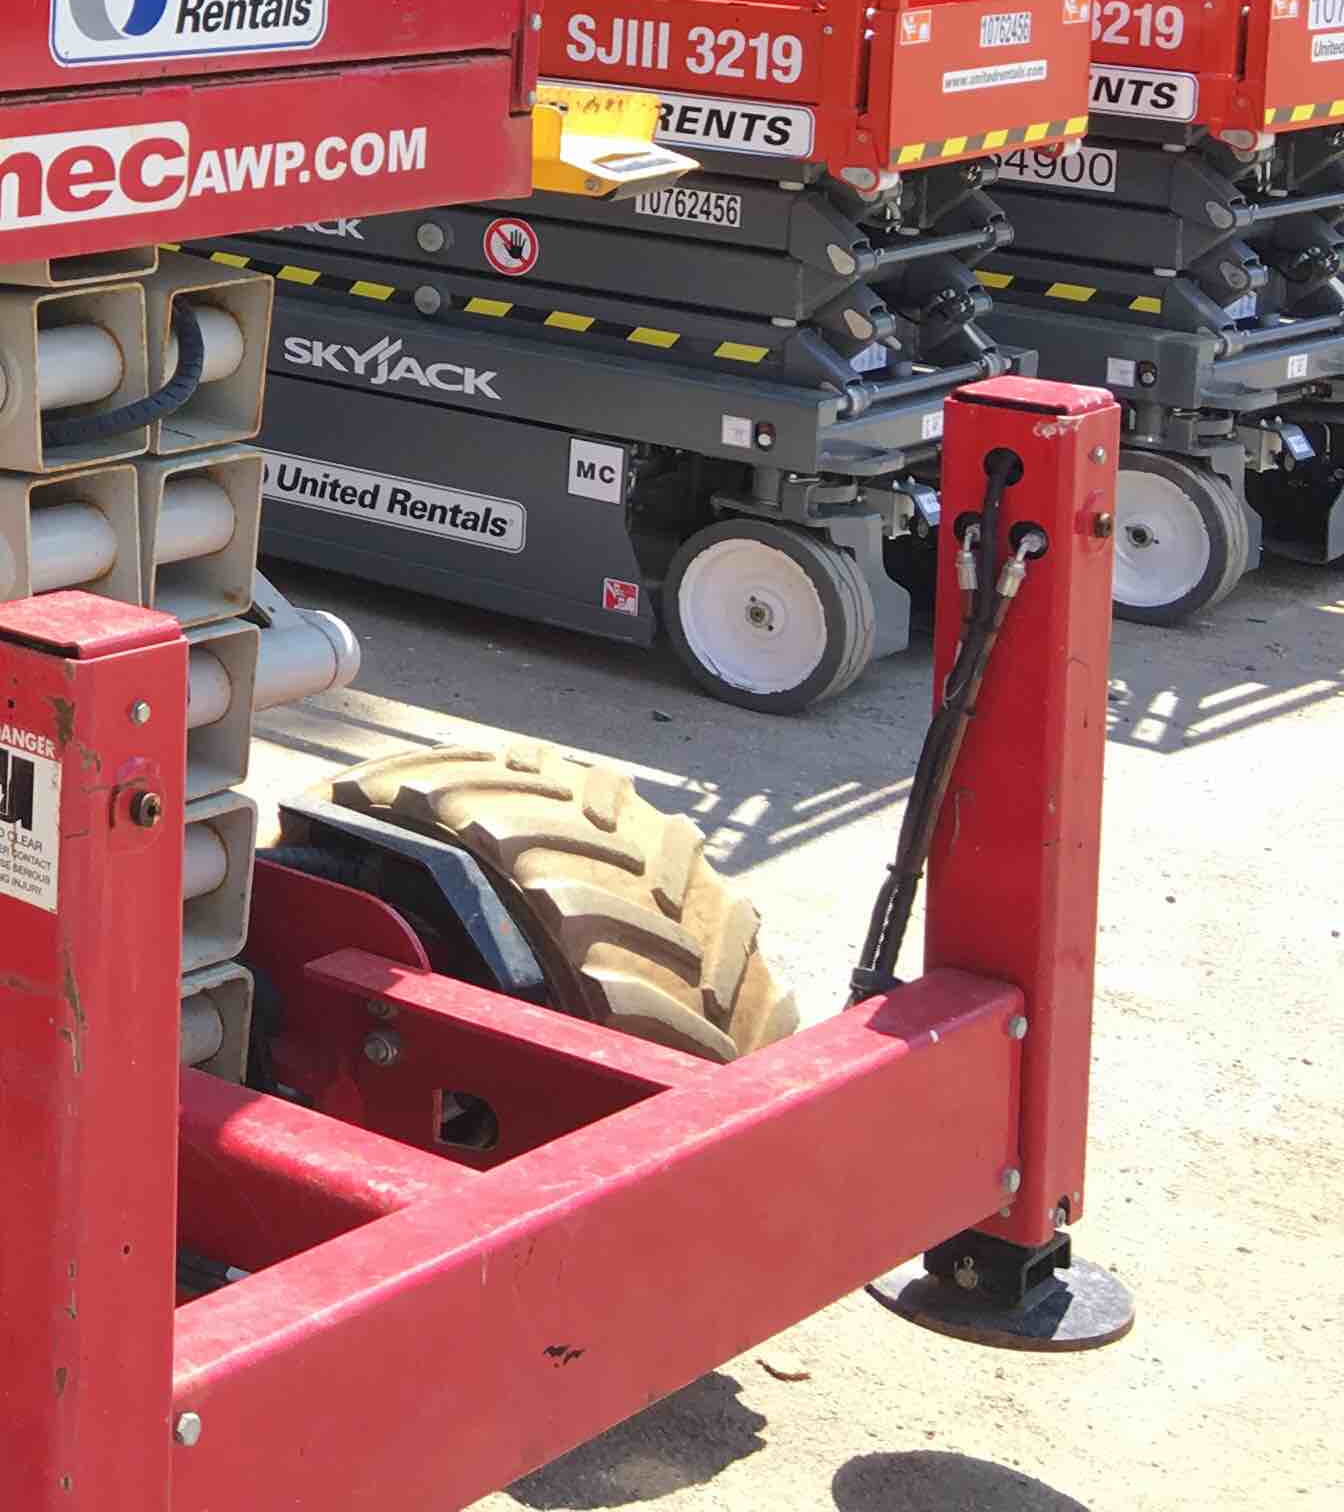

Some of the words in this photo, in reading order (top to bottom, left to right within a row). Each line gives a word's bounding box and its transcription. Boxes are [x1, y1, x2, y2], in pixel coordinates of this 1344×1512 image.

[686, 26, 803, 84] 3219
[640, 188, 738, 225] 10762456
[284, 336, 502, 400] SKYJACK
[277, 464, 380, 510] United
[387, 488, 508, 538] Rentals
[7, 830, 43, 852] CLEAR
[12, 850, 51, 870] CONTACT
[13, 862, 51, 884] SERIOUS
